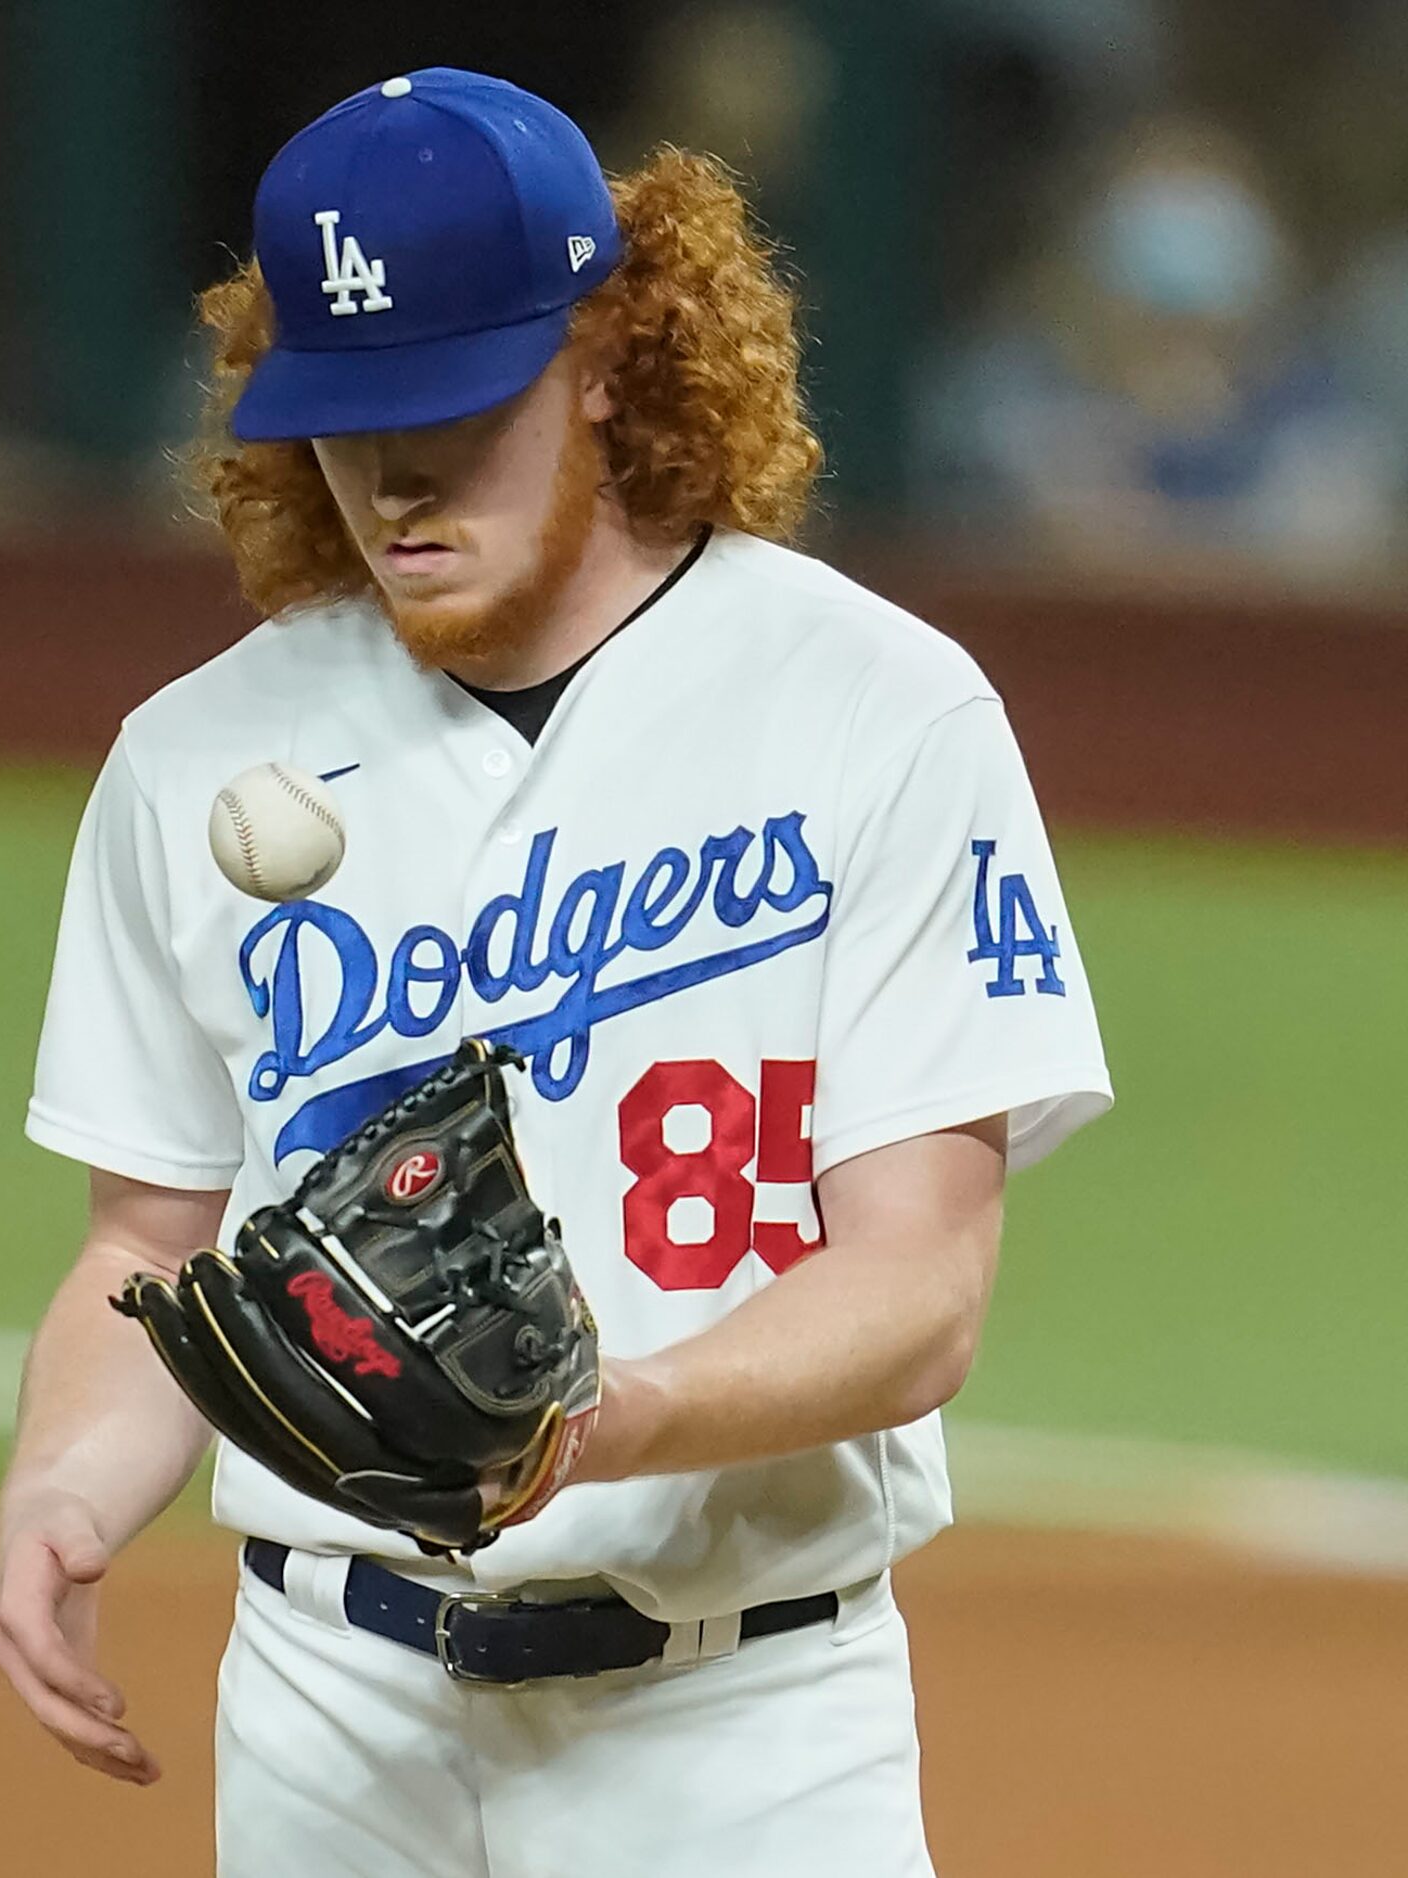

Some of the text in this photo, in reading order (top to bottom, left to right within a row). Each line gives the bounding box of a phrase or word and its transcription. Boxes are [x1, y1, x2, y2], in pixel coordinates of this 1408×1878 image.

[315, 210, 392, 315] LA
[240, 811, 834, 1101] Dodgers
[967, 839, 1066, 998] LA
